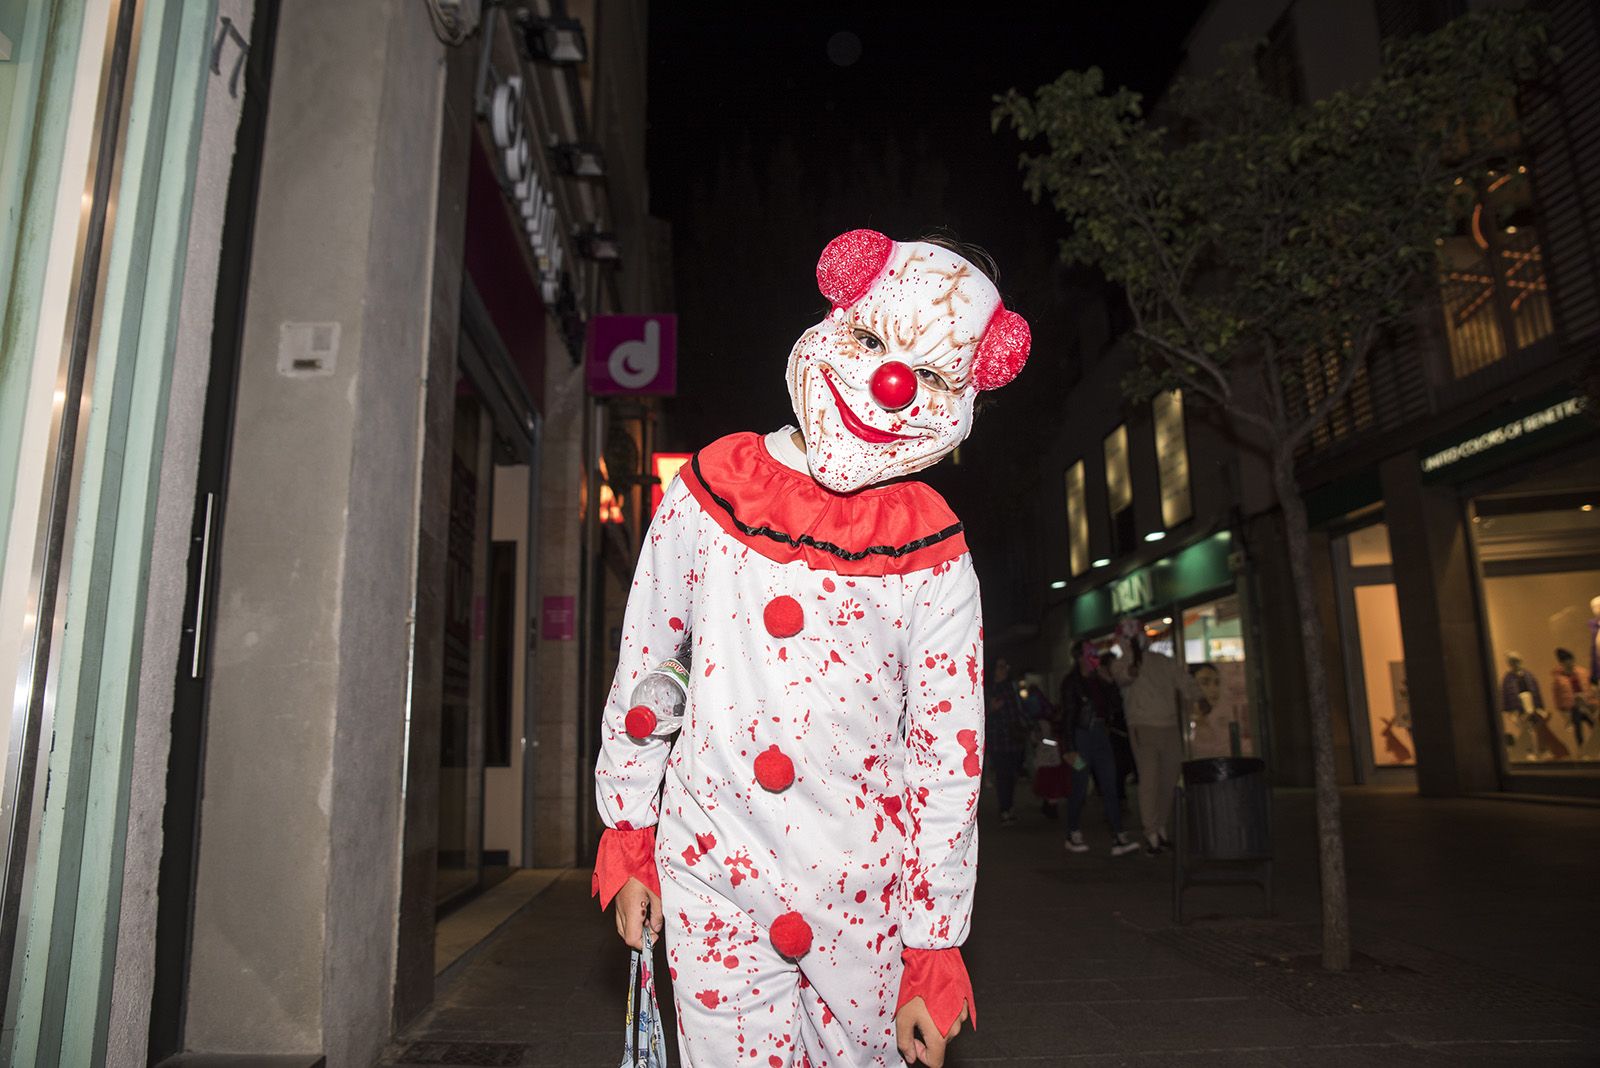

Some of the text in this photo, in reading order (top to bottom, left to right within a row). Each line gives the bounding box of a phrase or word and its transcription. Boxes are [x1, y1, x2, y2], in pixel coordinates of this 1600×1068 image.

[609, 321, 660, 389] d
[1422, 447, 1458, 472] UNITED
[1457, 427, 1506, 457] COLORS
[1506, 419, 1524, 440] OF
